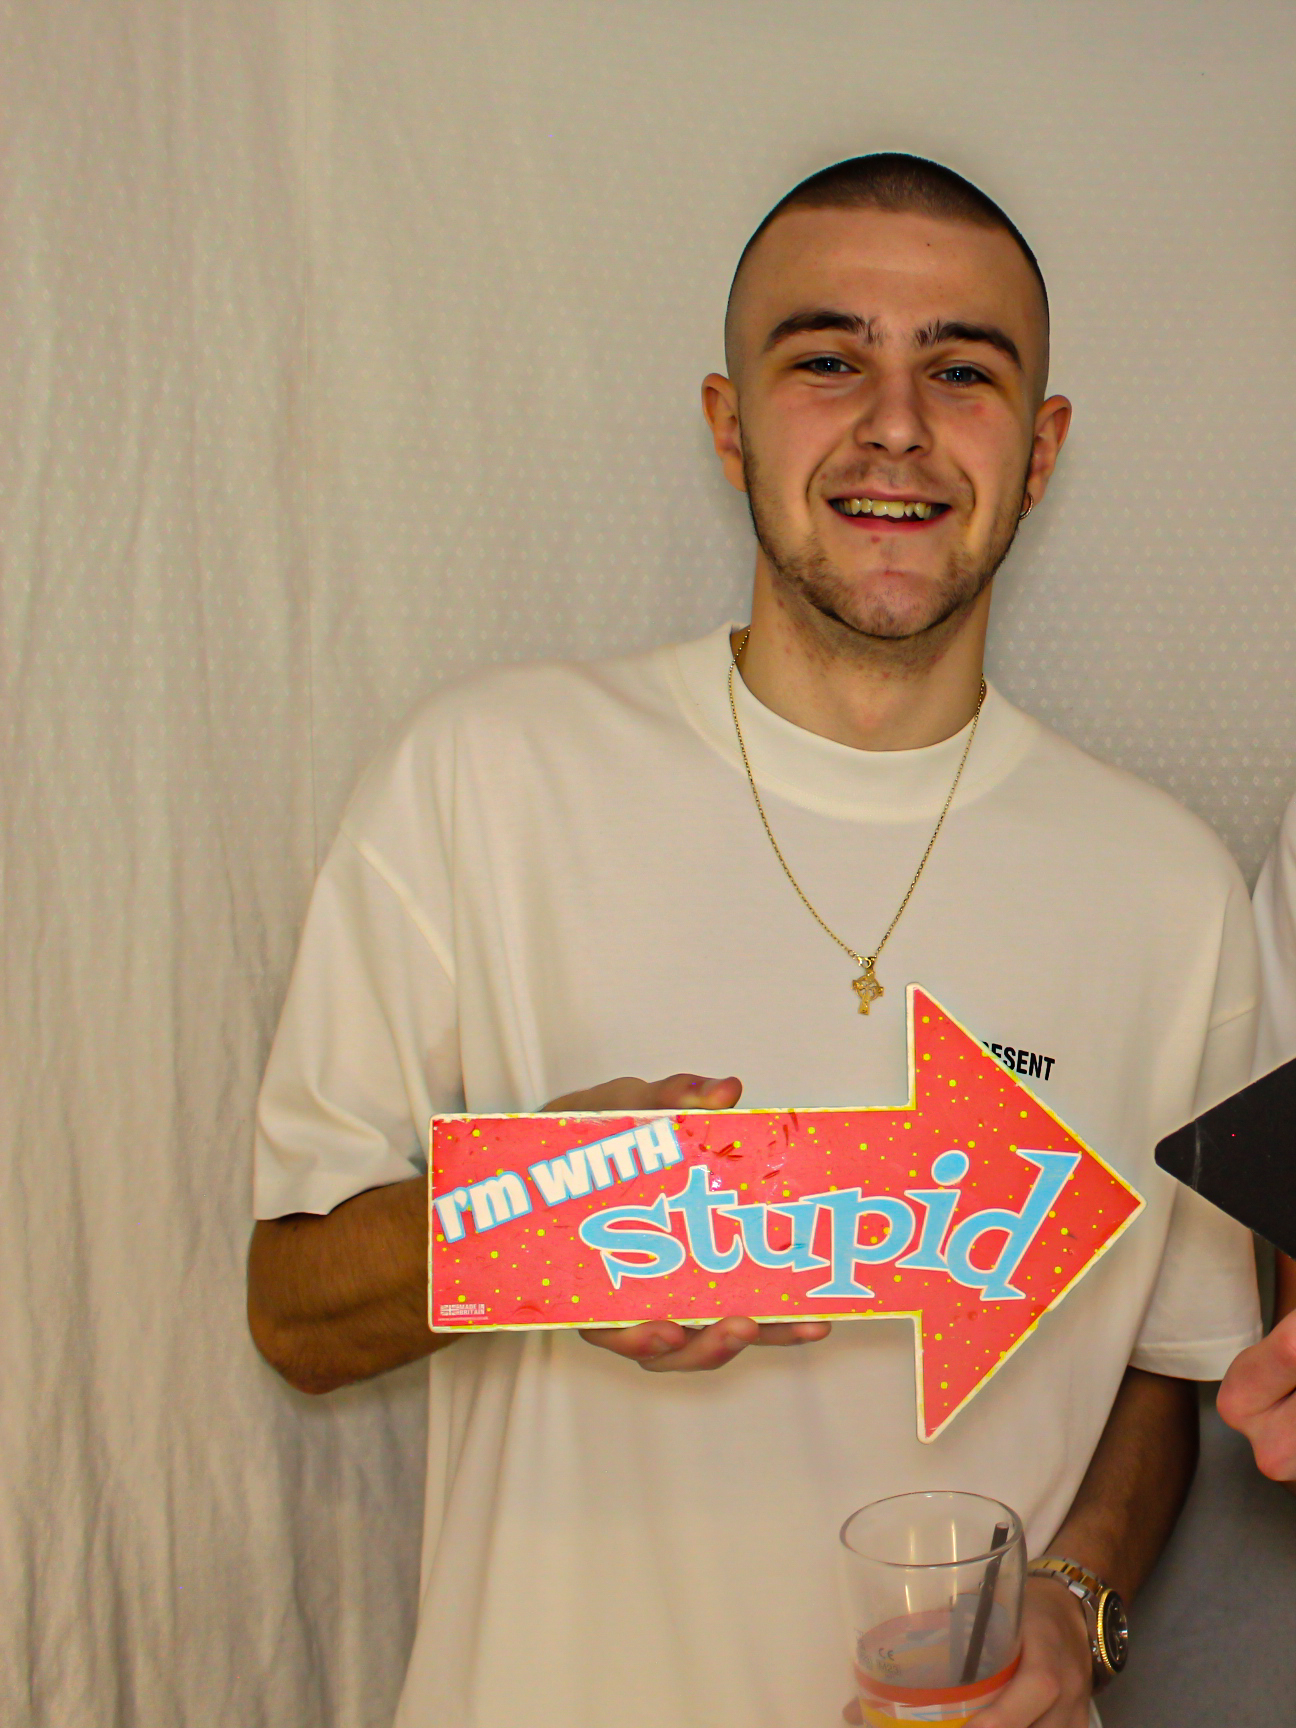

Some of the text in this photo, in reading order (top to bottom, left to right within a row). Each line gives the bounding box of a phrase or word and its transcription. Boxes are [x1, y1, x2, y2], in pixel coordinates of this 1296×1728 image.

[982, 1041, 1055, 1081] ESENT
[528, 1117, 684, 1206] WITH
[579, 1149, 1081, 1301] stupid
